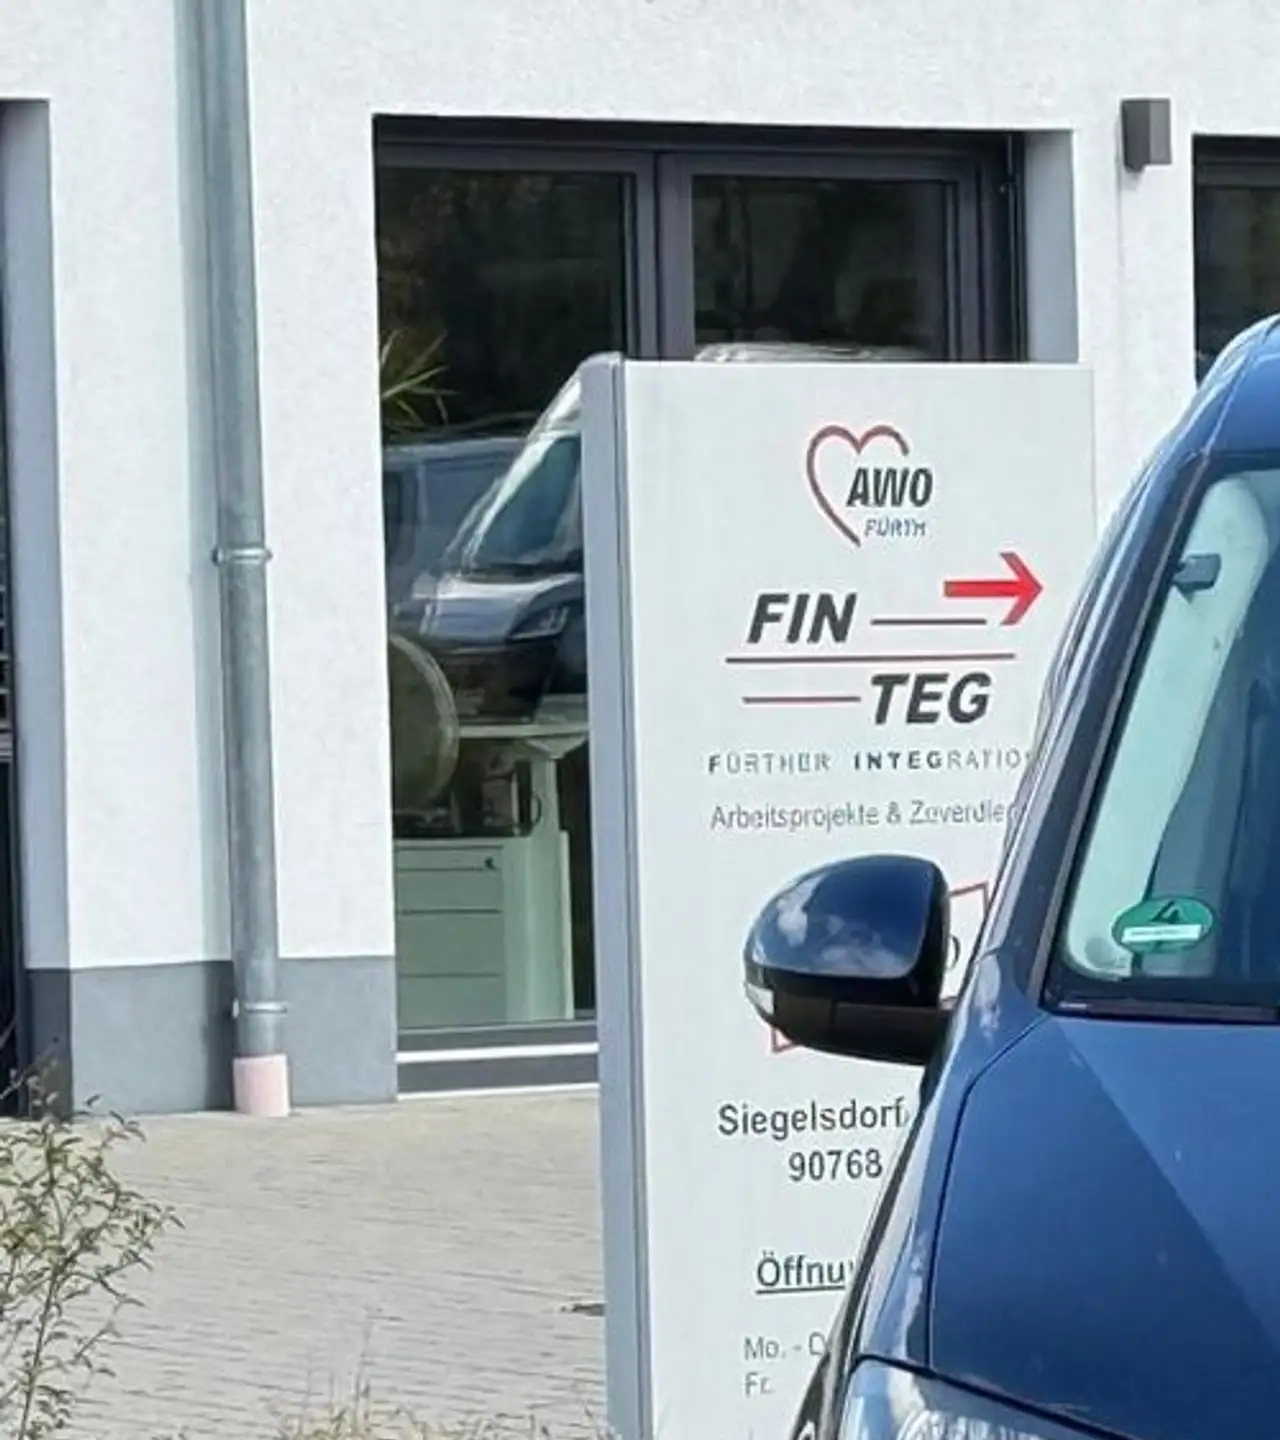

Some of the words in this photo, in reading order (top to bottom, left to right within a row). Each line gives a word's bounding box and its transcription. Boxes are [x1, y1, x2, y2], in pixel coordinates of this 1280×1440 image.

[846, 467, 934, 508] AWO
[864, 518, 927, 538] FÜRTH
[746, 592, 858, 645] FIN
[870, 671, 992, 725] TEG
[707, 750, 832, 775] FÜRTHER
[853, 748, 1030, 773] INTEGRATIO
[710, 801, 879, 834] Arbeitsprojekte
[885, 801, 901, 824] &
[717, 1095, 909, 1143] Siegelsdorf
[788, 1147, 883, 1183] 90768
[756, 1249, 853, 1288] Öffnu
[808, 1331, 827, 1357] D
